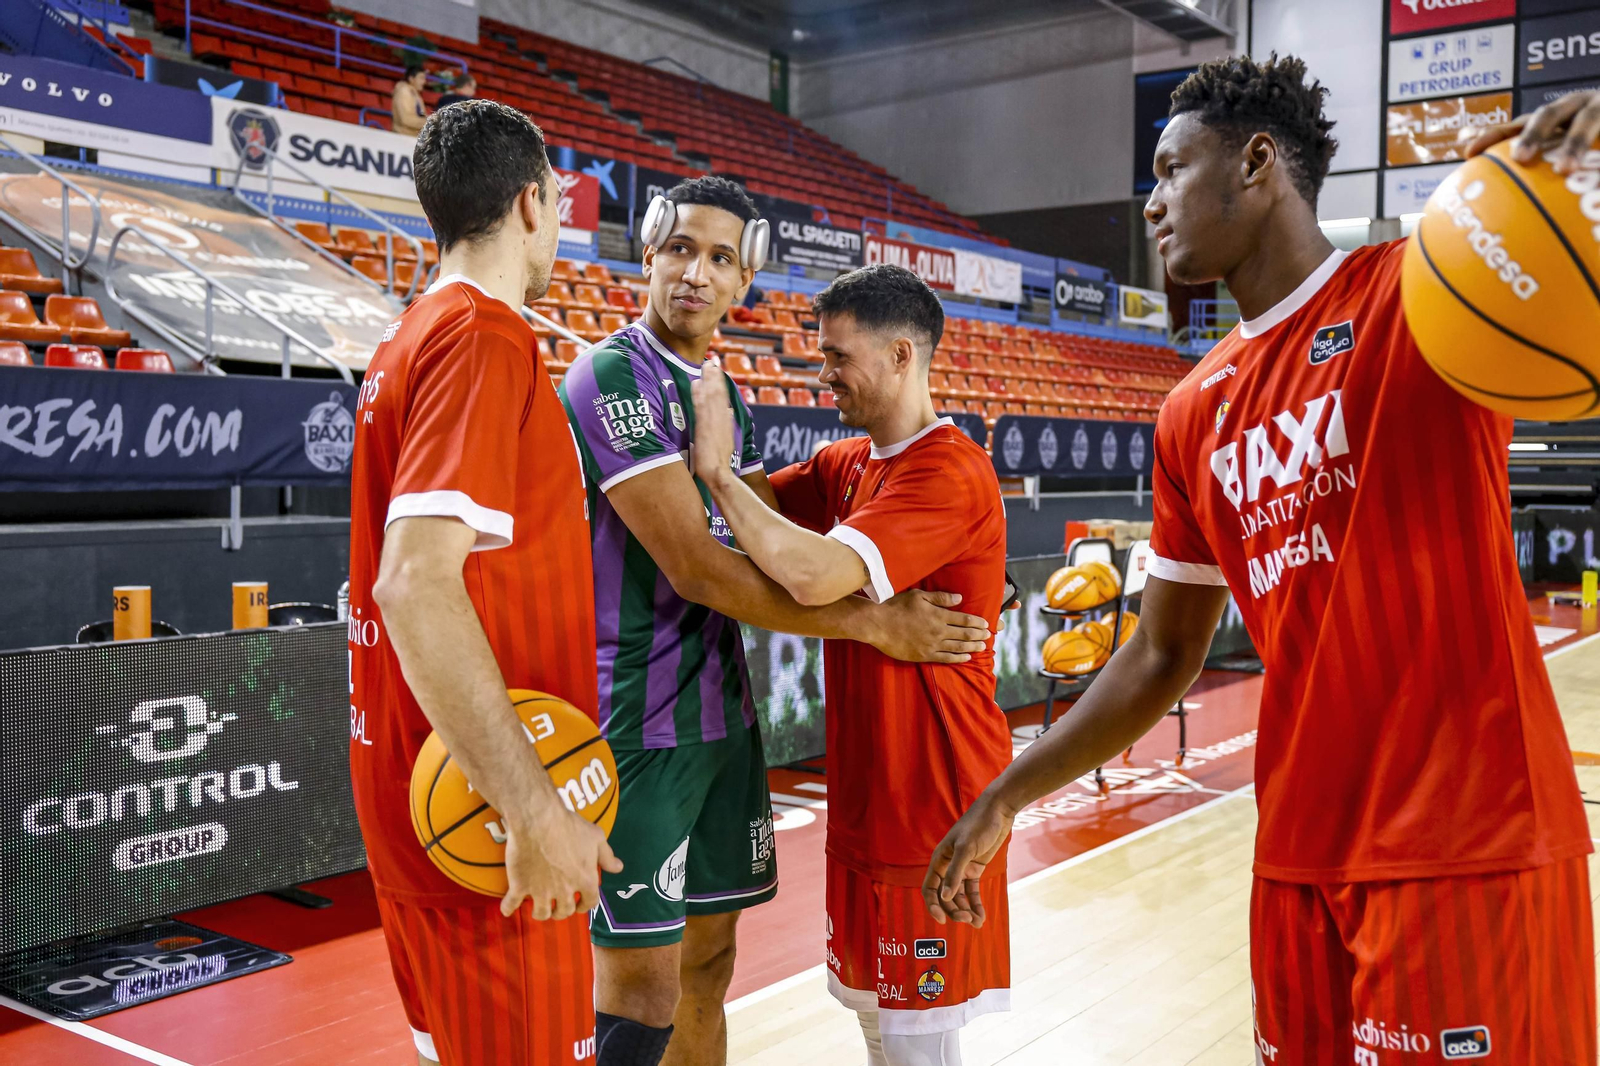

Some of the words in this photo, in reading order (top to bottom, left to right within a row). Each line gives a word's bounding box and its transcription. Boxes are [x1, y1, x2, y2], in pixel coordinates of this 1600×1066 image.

[1399, 71, 1502, 96] PETROBAGES
[1428, 58, 1472, 76] GRUP
[0, 72, 113, 107] VOLVO
[289, 134, 414, 181] SCANIA
[592, 391, 619, 406] sabor
[308, 424, 353, 442] BAXI
[1210, 389, 1350, 512] BAXI
[22, 761, 299, 835] CONTROL
[130, 829, 214, 865] GROUP
[918, 946, 940, 956] acb
[47, 953, 199, 996] acb
[1352, 1017, 1431, 1053] Adhisio
[1447, 1038, 1481, 1055] acb
